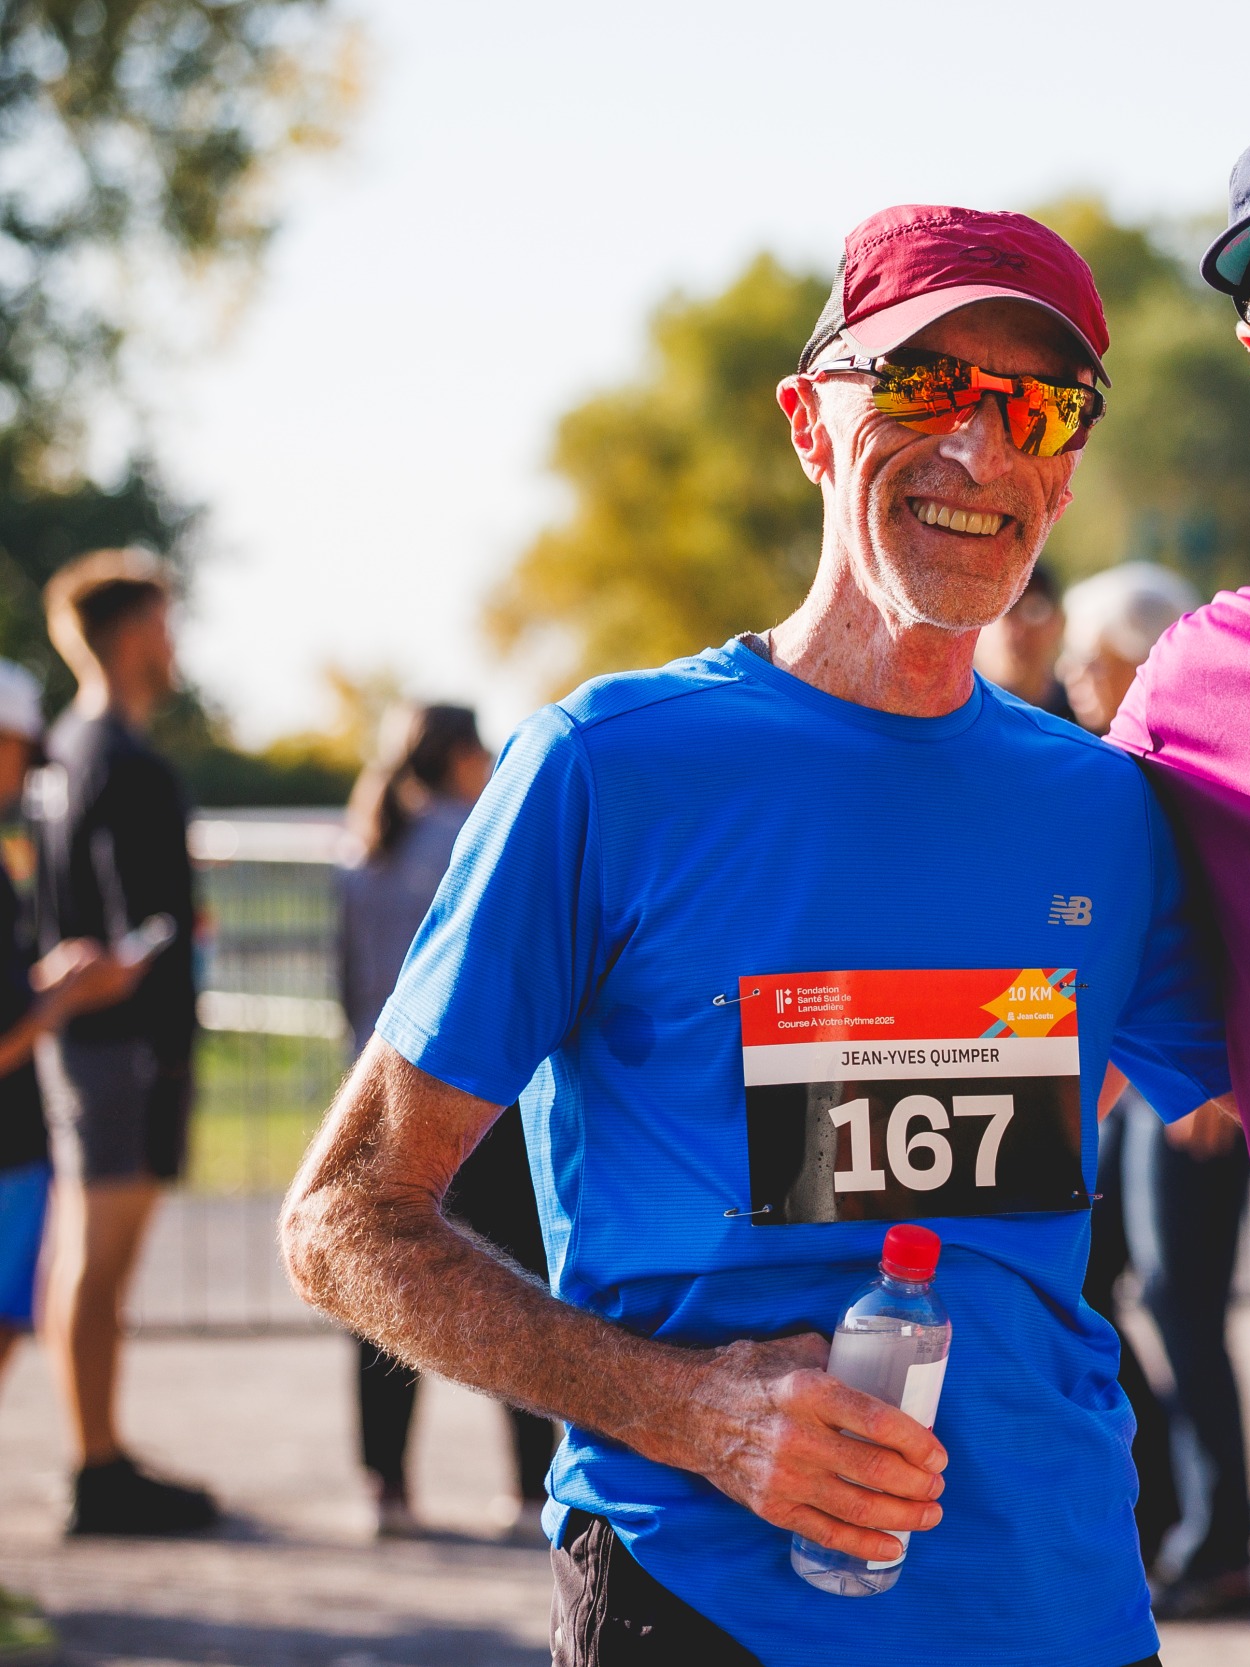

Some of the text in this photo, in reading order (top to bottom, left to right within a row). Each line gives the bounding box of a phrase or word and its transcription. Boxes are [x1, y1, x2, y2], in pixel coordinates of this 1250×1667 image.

[797, 986, 839, 995] Fondation
[1008, 986, 1052, 1001] 10 KM
[797, 994, 852, 1004] Santé Sud de
[798, 1003, 844, 1013] Lanaudière
[1034, 1012, 1054, 1020] Coutu
[778, 1016, 895, 1029] Course À Votre Rythme 2025
[841, 1048, 1000, 1067] JEAN-YVES QUIMPER
[828, 1094, 1014, 1192] 167
